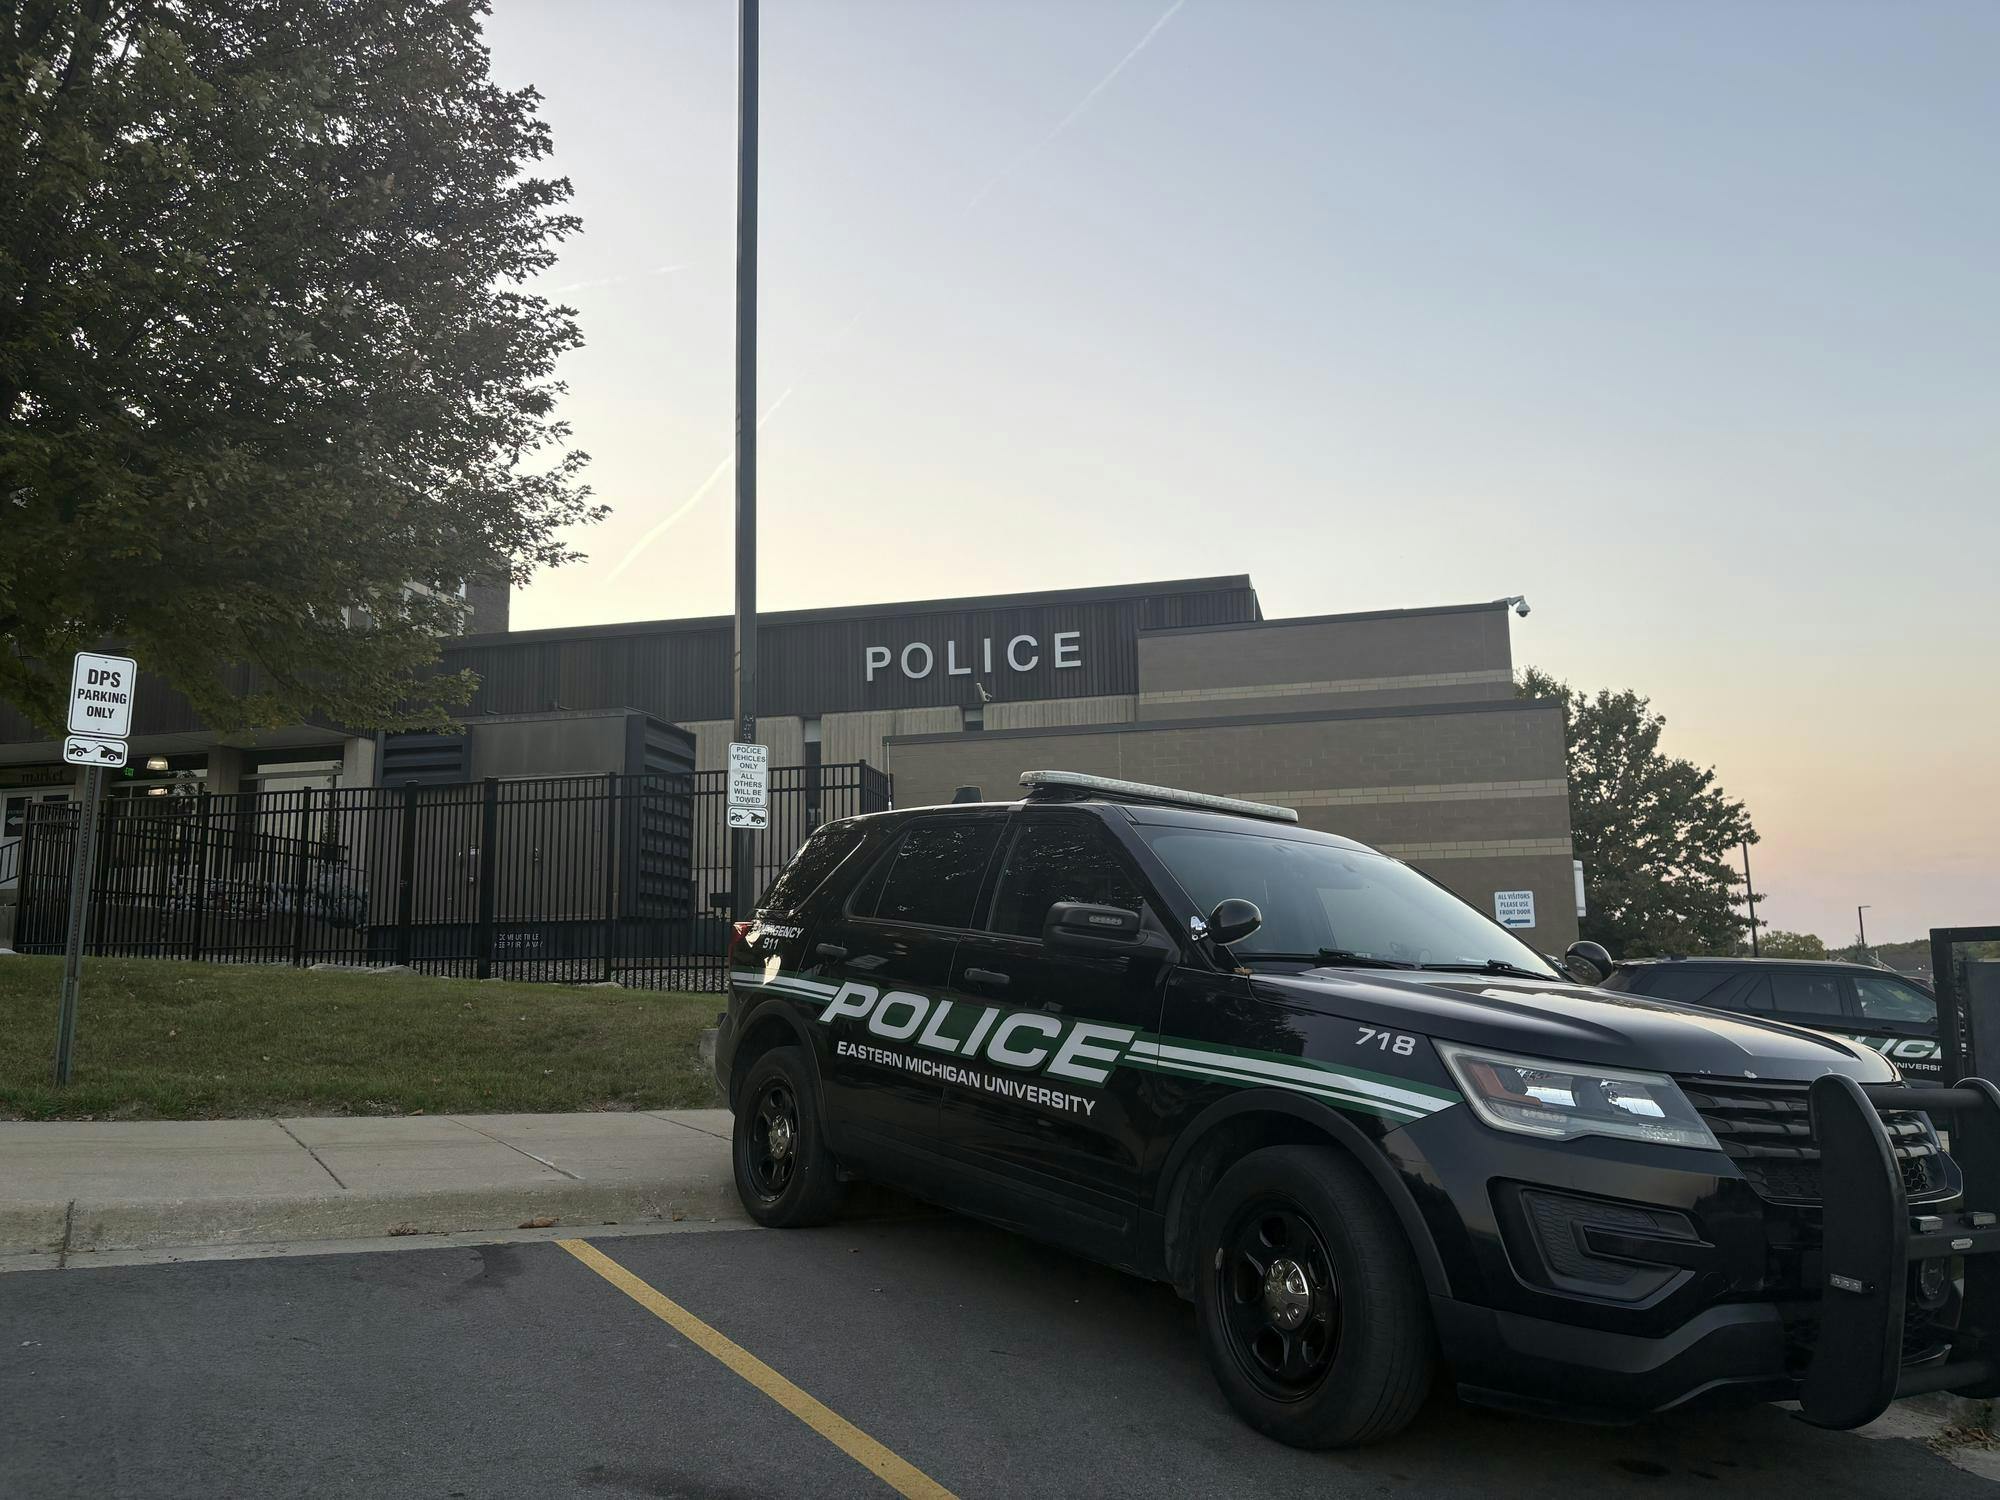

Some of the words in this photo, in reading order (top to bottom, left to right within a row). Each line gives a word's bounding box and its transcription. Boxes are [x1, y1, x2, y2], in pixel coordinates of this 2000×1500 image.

[866, 631, 1082, 682] POLICE
[87, 668, 121, 688] DPS
[77, 688, 127, 704] PARKING
[86, 705, 115, 719] ONLY
[736, 746, 762, 755] POLICE
[732, 754, 766, 763] VEHICLES
[739, 762, 758, 770] ONLY
[740, 772, 754, 780] ALL
[733, 780, 762, 788] OTHERS
[733, 788, 751, 796] WILL
[752, 788, 762, 796] BE
[735, 796, 761, 804] TOWED
[762, 937, 780, 950] 911
[818, 981, 1135, 1084] POLICE
[1355, 1027, 1416, 1057] 718
[1894, 1061, 1943, 1072] NIVERSI
[837, 1040, 902, 1068] EASTERN
[905, 1057, 981, 1088] MICHIGAN
[984, 1074, 1096, 1117] UNIVERSITY
